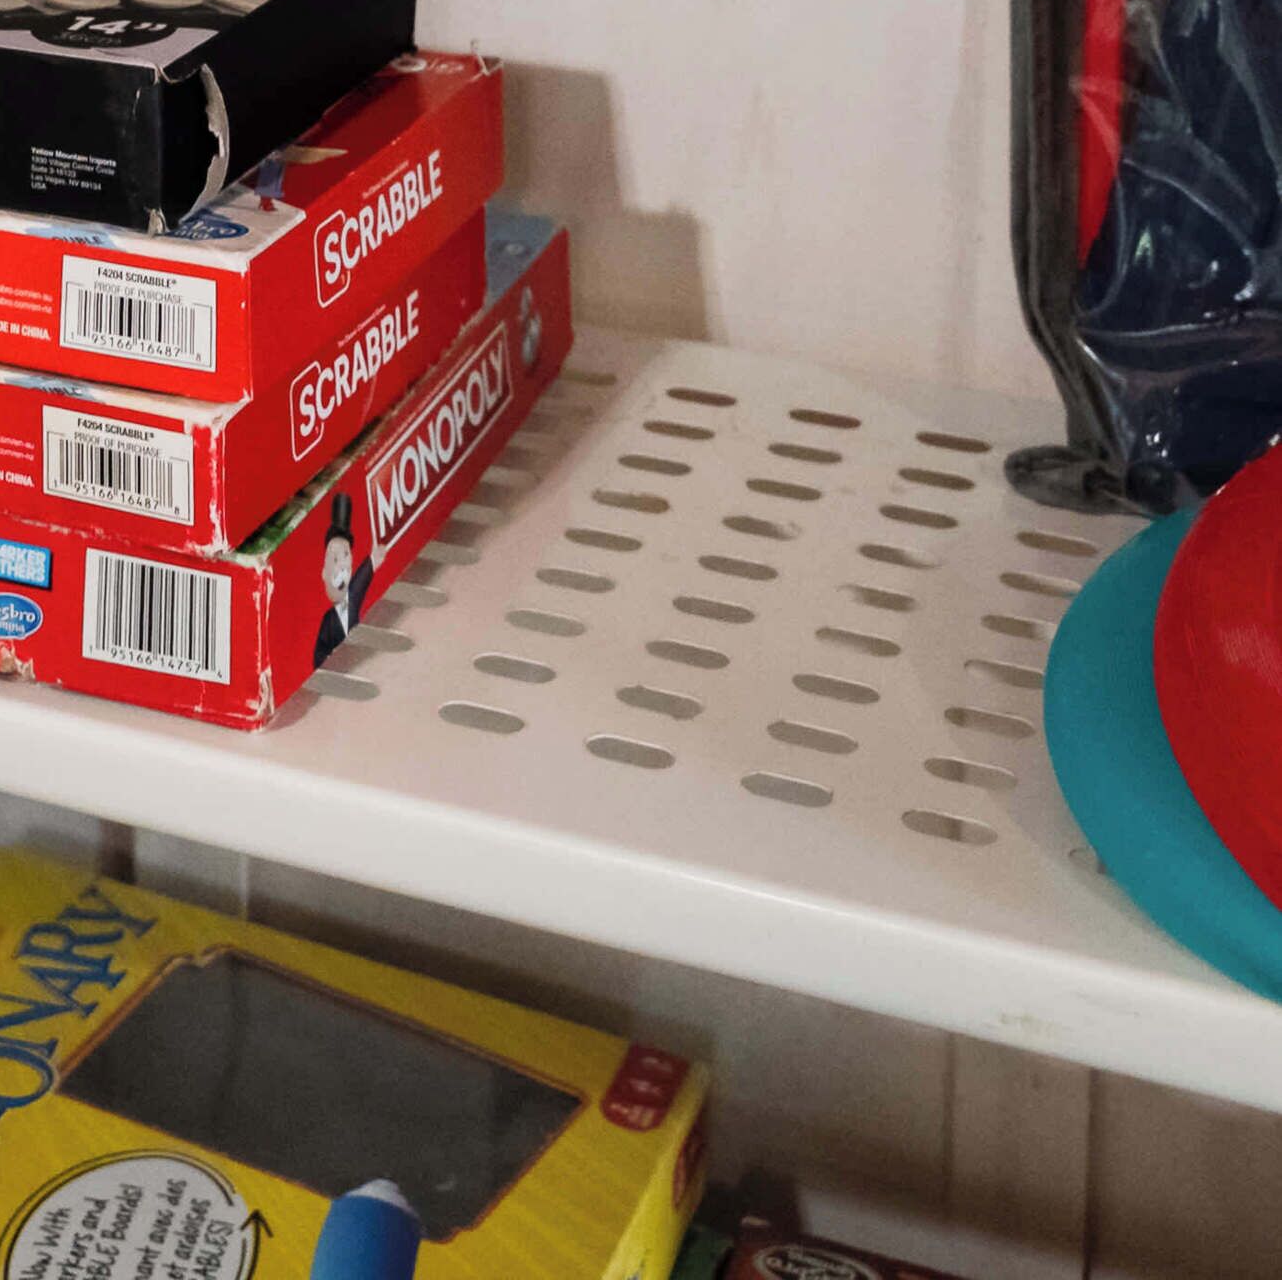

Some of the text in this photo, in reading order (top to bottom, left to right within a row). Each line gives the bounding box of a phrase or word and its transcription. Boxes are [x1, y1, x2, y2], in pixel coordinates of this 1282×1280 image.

[324, 149, 444, 285] SCRABBLE
[97, 266, 123, 281] F4204
[94, 281, 121, 294] PROOF
[137, 289, 183, 304] PURCHASE
[298, 289, 420, 439] SCRABBLE
[77, 418, 103, 432] F4204
[74, 432, 101, 445] PROOF
[117, 440, 161, 458] PURCHASE
[374, 340, 508, 540] MONOPOLY
[74, 482, 114, 501] 95166
[120, 492, 160, 510] 16487
[110, 647, 153, 666] 95166
[160, 657, 202, 675] 14757
